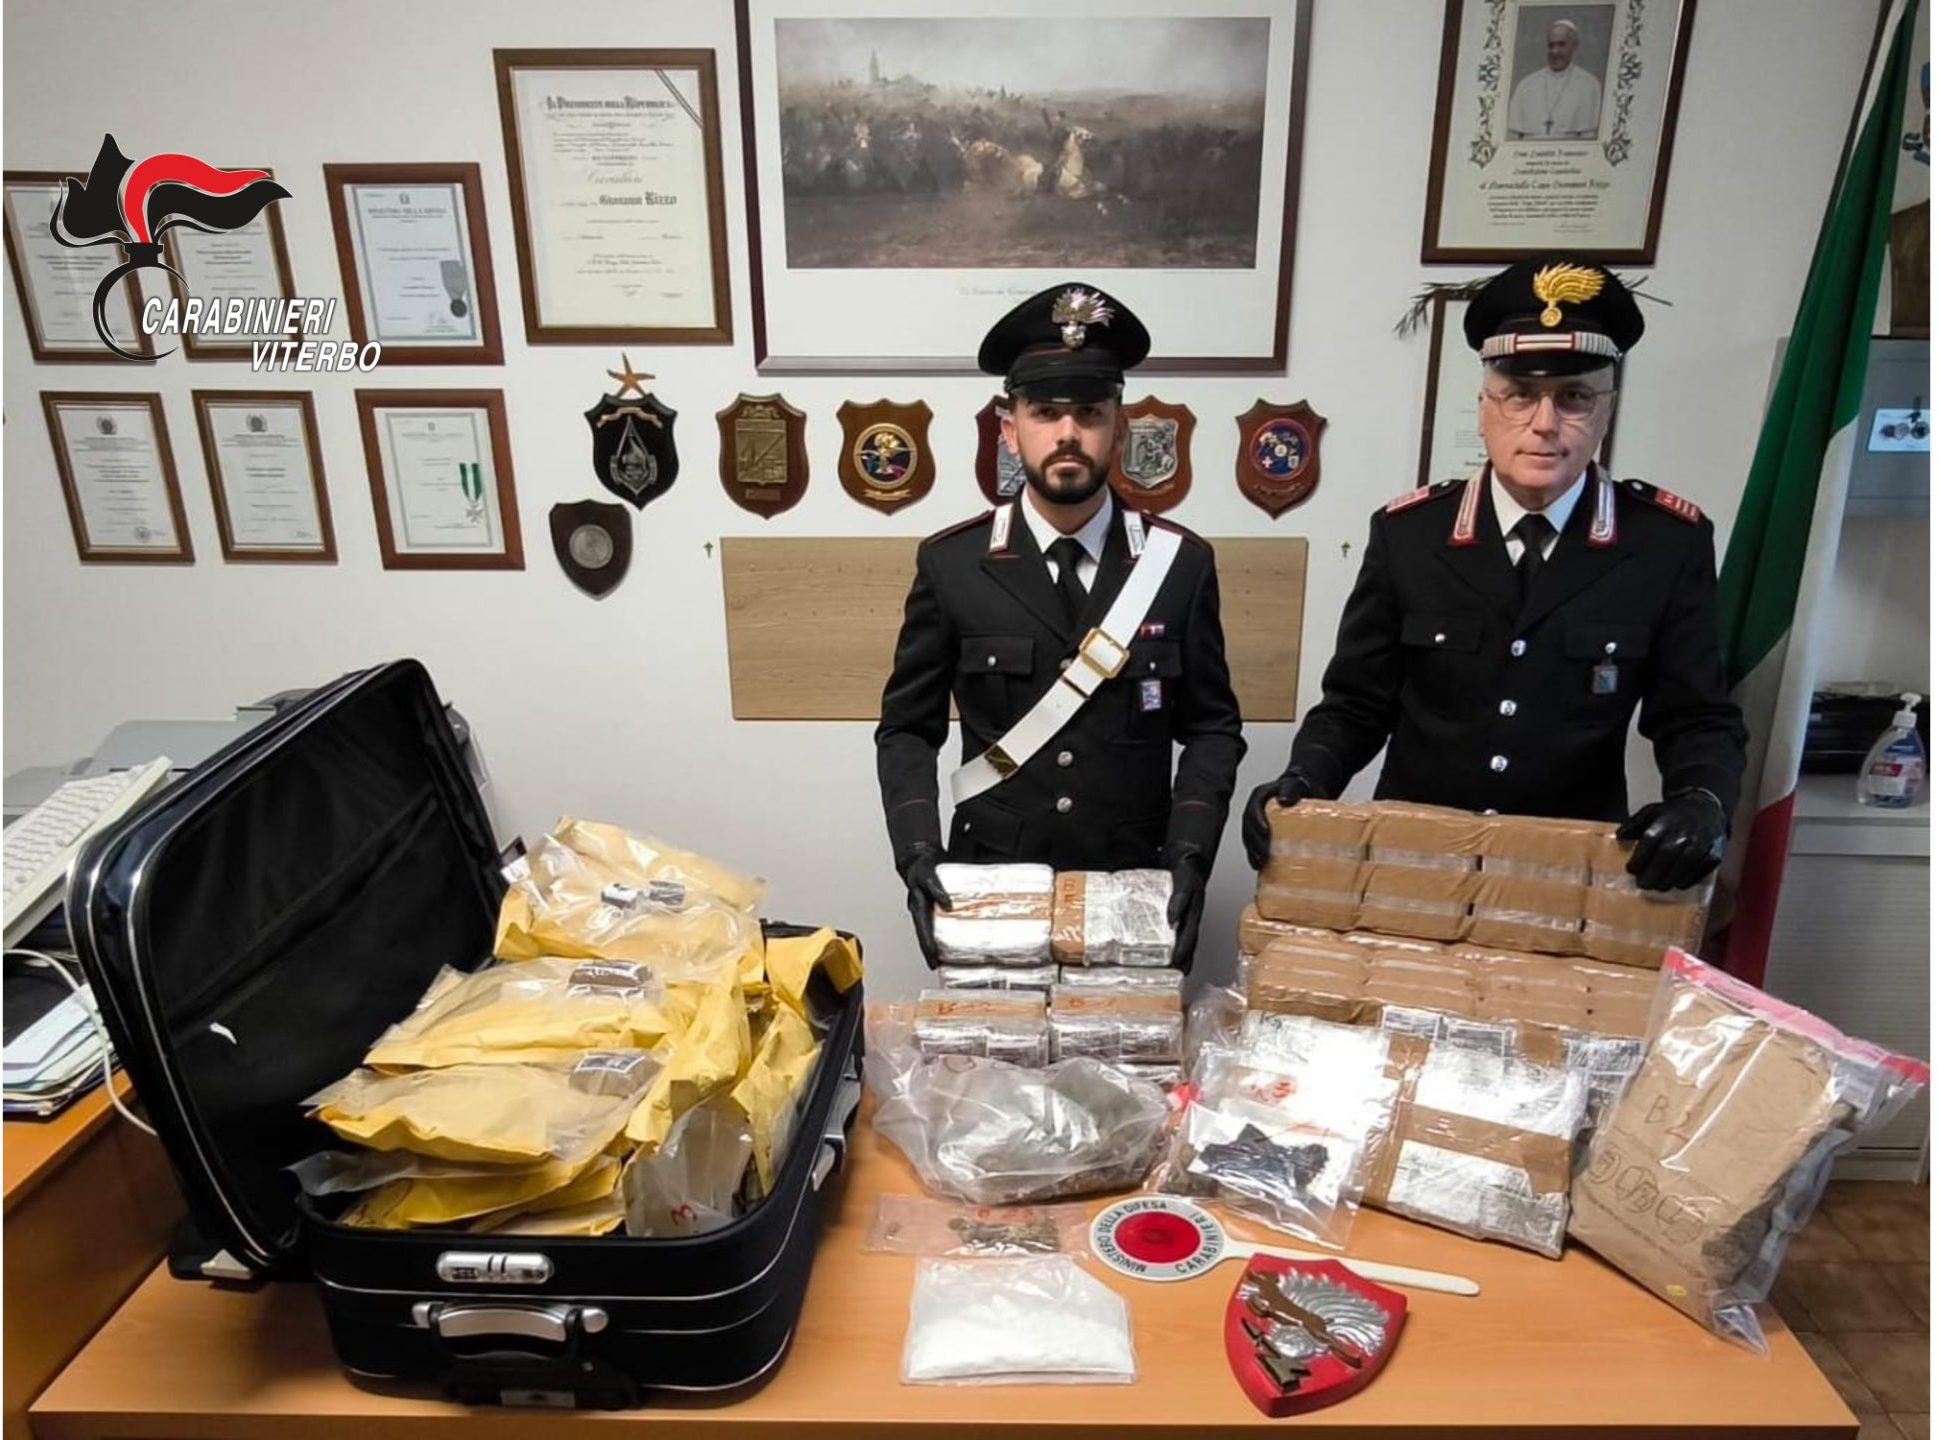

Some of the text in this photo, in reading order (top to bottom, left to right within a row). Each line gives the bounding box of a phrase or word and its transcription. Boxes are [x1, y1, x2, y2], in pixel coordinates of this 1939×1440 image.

[1097, 1200, 1168, 1273] MINISTERO DELLA DIFESA
[1175, 1212, 1220, 1274] CARABINIERI
